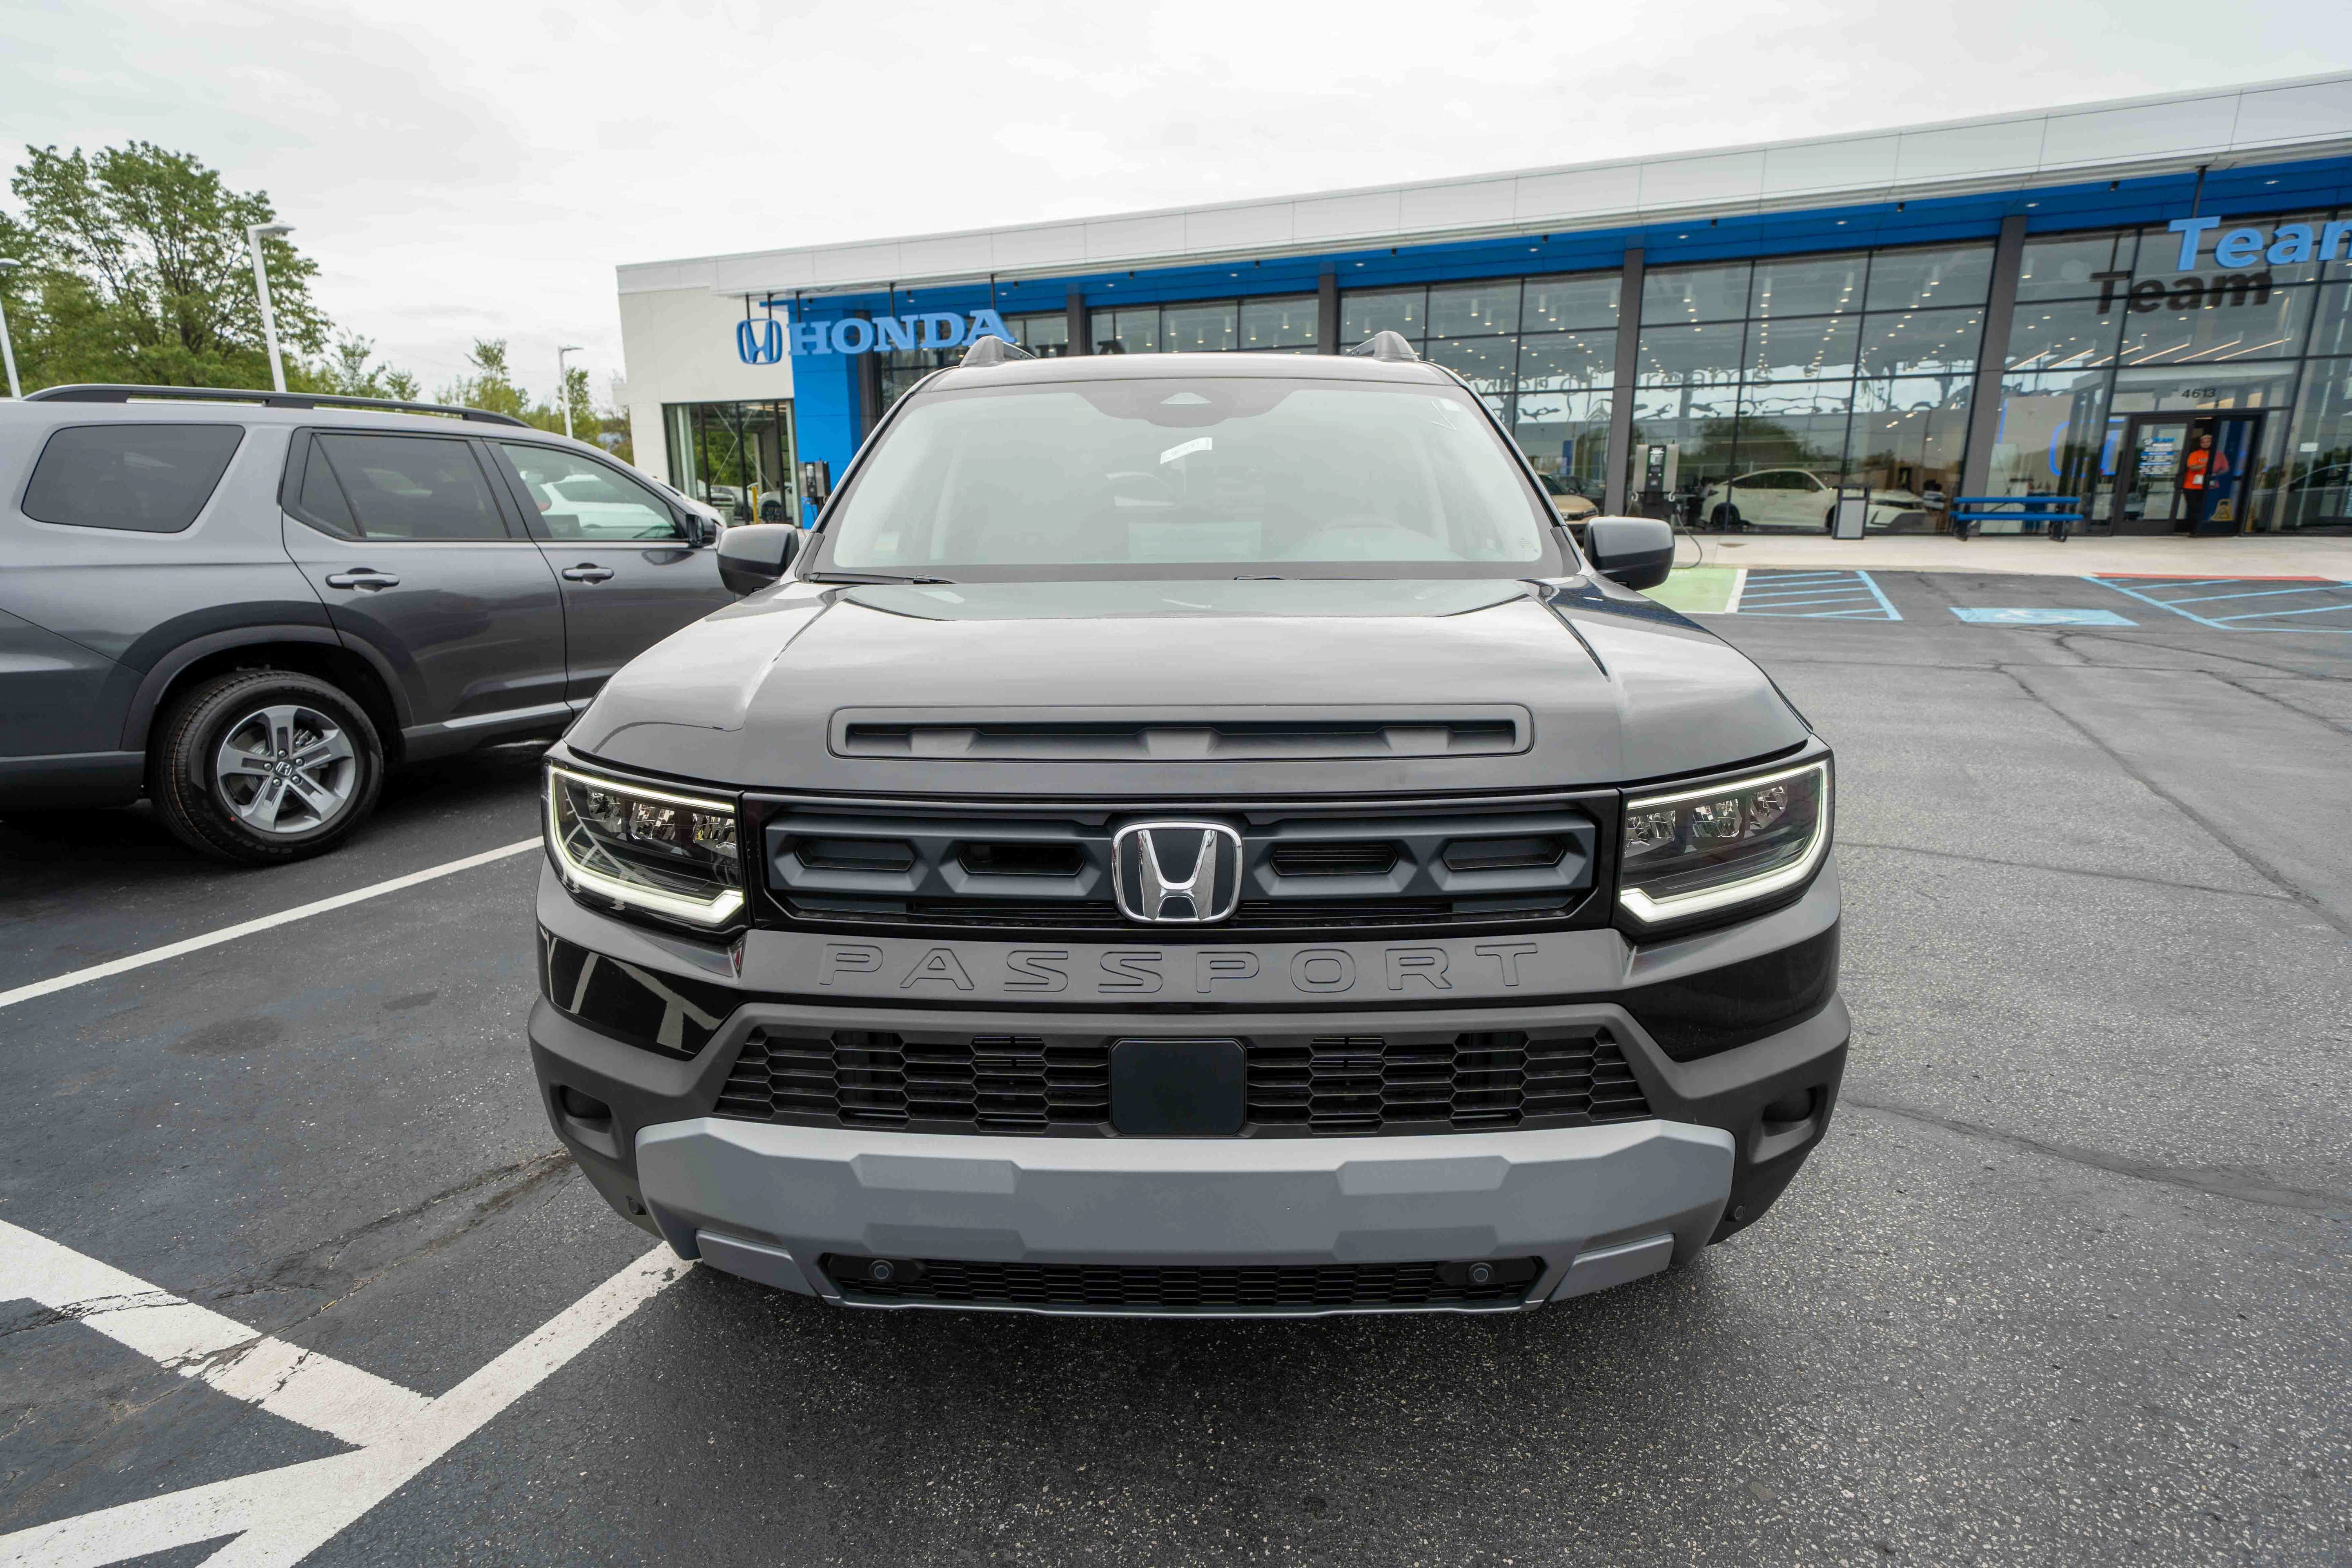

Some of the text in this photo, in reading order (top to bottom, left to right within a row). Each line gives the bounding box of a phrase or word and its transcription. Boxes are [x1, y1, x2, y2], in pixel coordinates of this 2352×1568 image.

[787, 309, 1016, 355] HONDA
[2181, 386, 2216, 398] 4613
[818, 942, 1539, 994] PASSPORT
